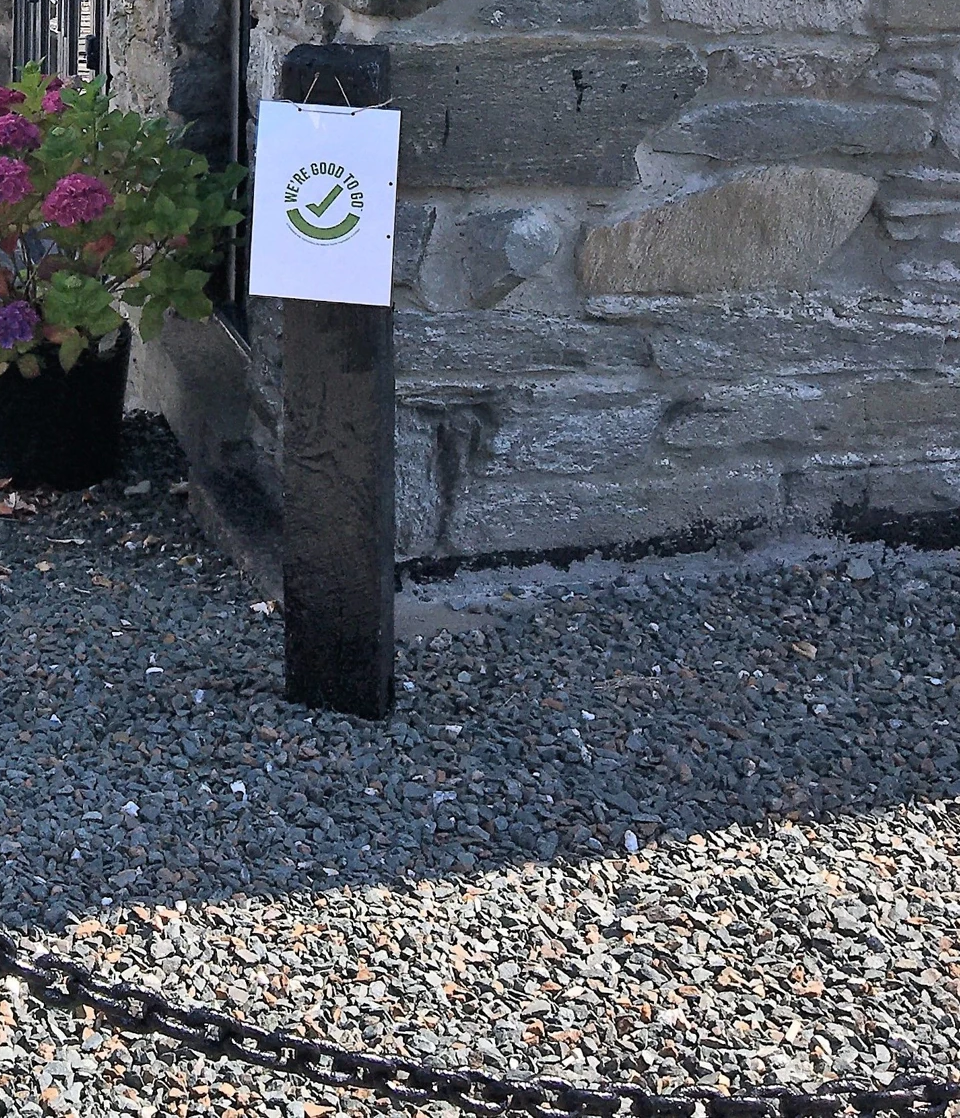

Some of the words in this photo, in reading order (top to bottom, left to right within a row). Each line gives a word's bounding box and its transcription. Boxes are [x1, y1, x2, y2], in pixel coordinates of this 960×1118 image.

[284, 167, 311, 203] WE'RE
[310, 162, 345, 179] GOOD
[343, 172, 360, 190] TO
